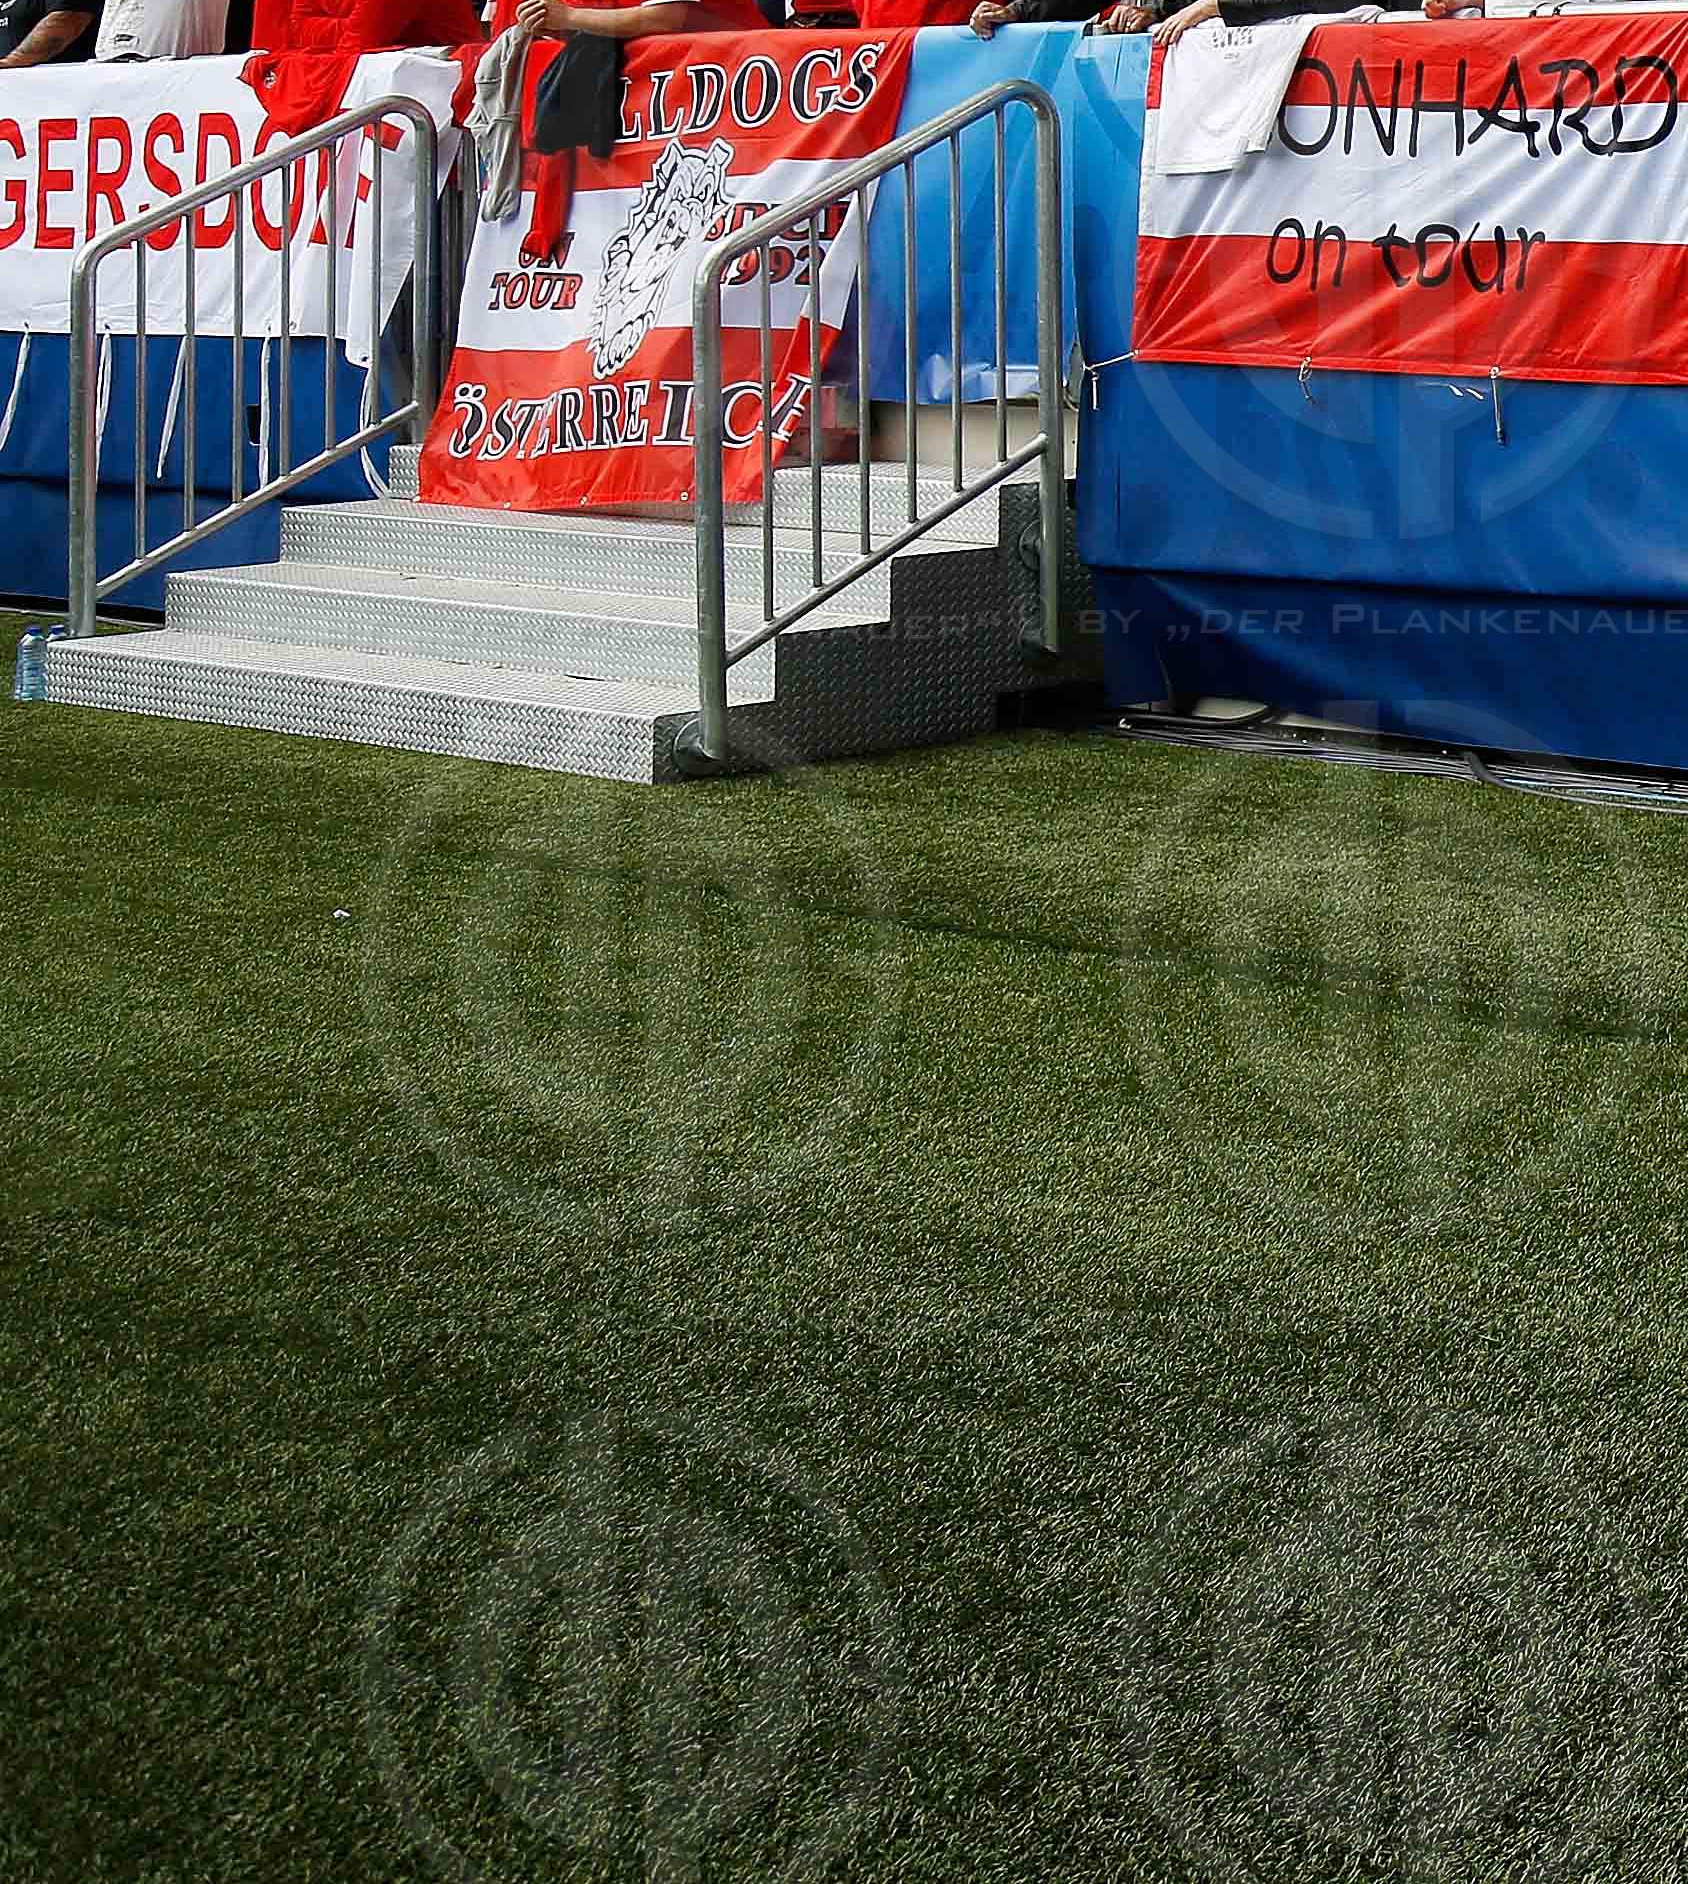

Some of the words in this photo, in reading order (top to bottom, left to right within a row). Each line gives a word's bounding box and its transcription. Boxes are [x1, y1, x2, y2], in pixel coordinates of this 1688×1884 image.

[1265, 217, 1348, 291] on
[1371, 218, 1547, 294] tour
[489, 268, 582, 312] TOUR
